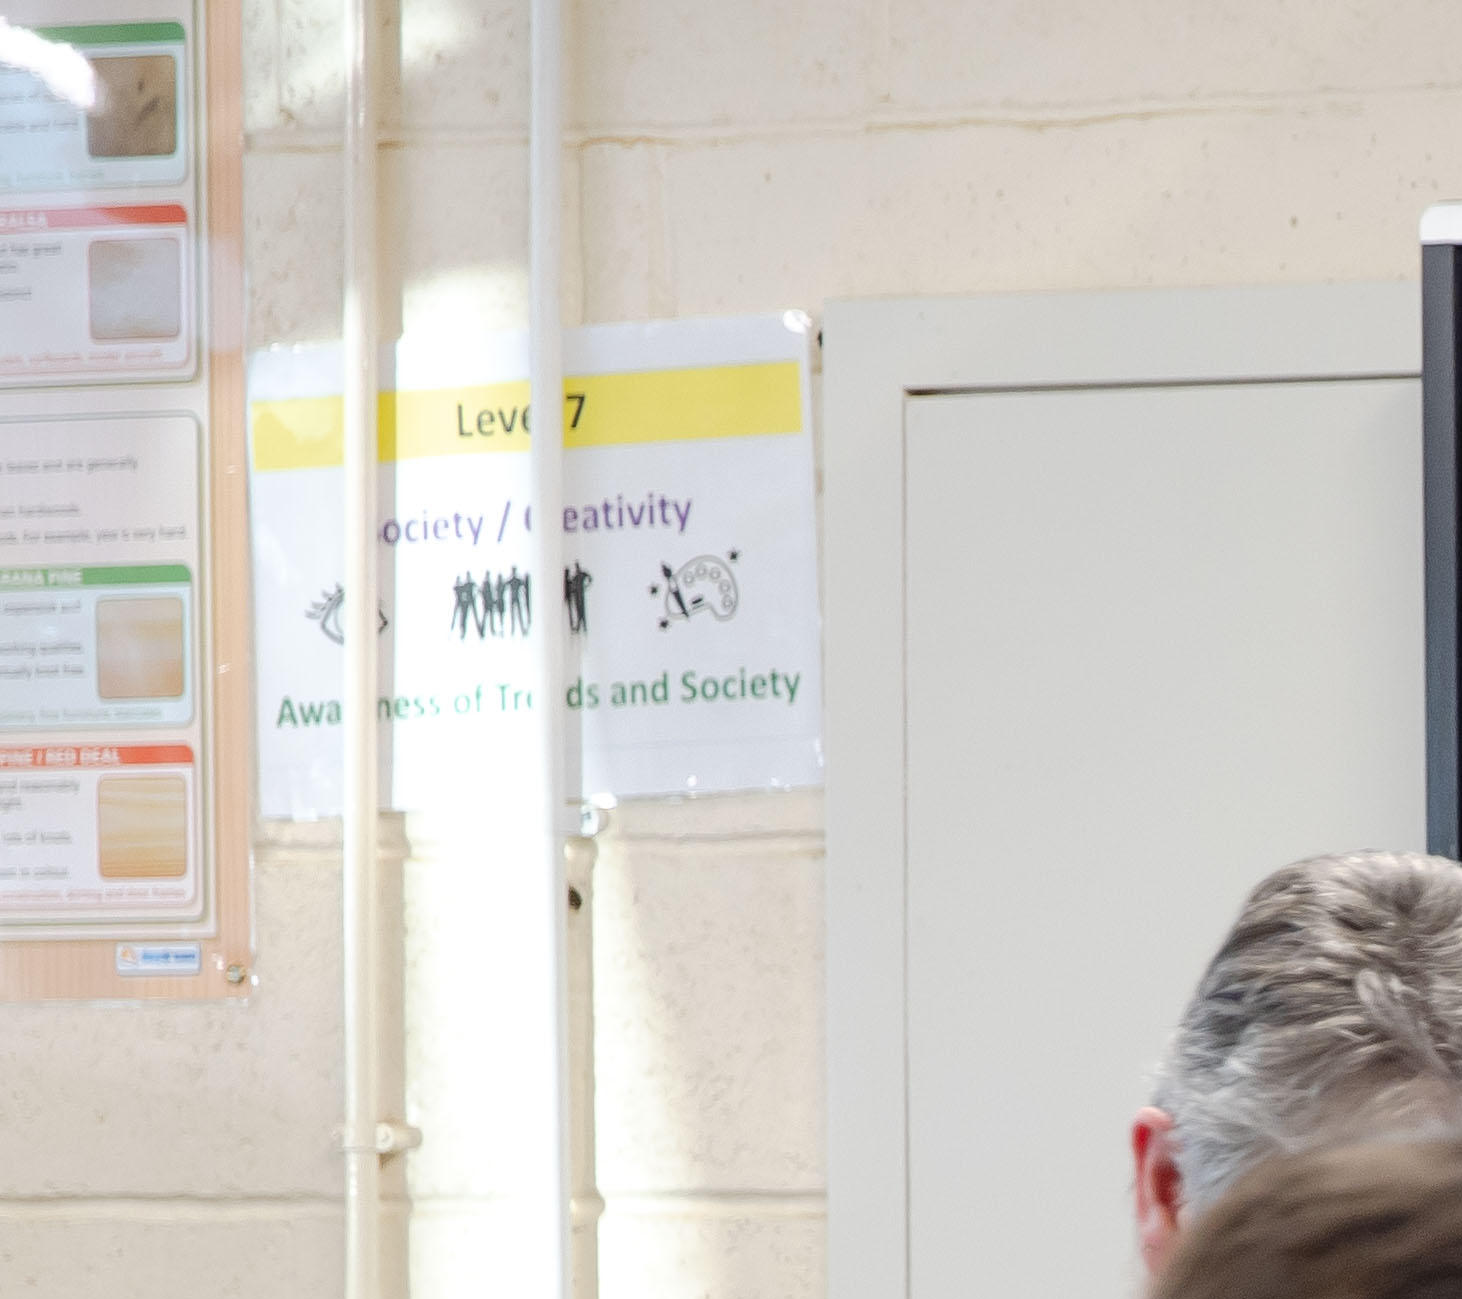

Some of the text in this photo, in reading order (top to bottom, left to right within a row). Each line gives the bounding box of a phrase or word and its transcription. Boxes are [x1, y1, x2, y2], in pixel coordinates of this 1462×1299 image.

[566, 393, 586, 429] 7
[524, 492, 692, 534] eativity
[277, 666, 801, 728] Awaness of Trds and Society
